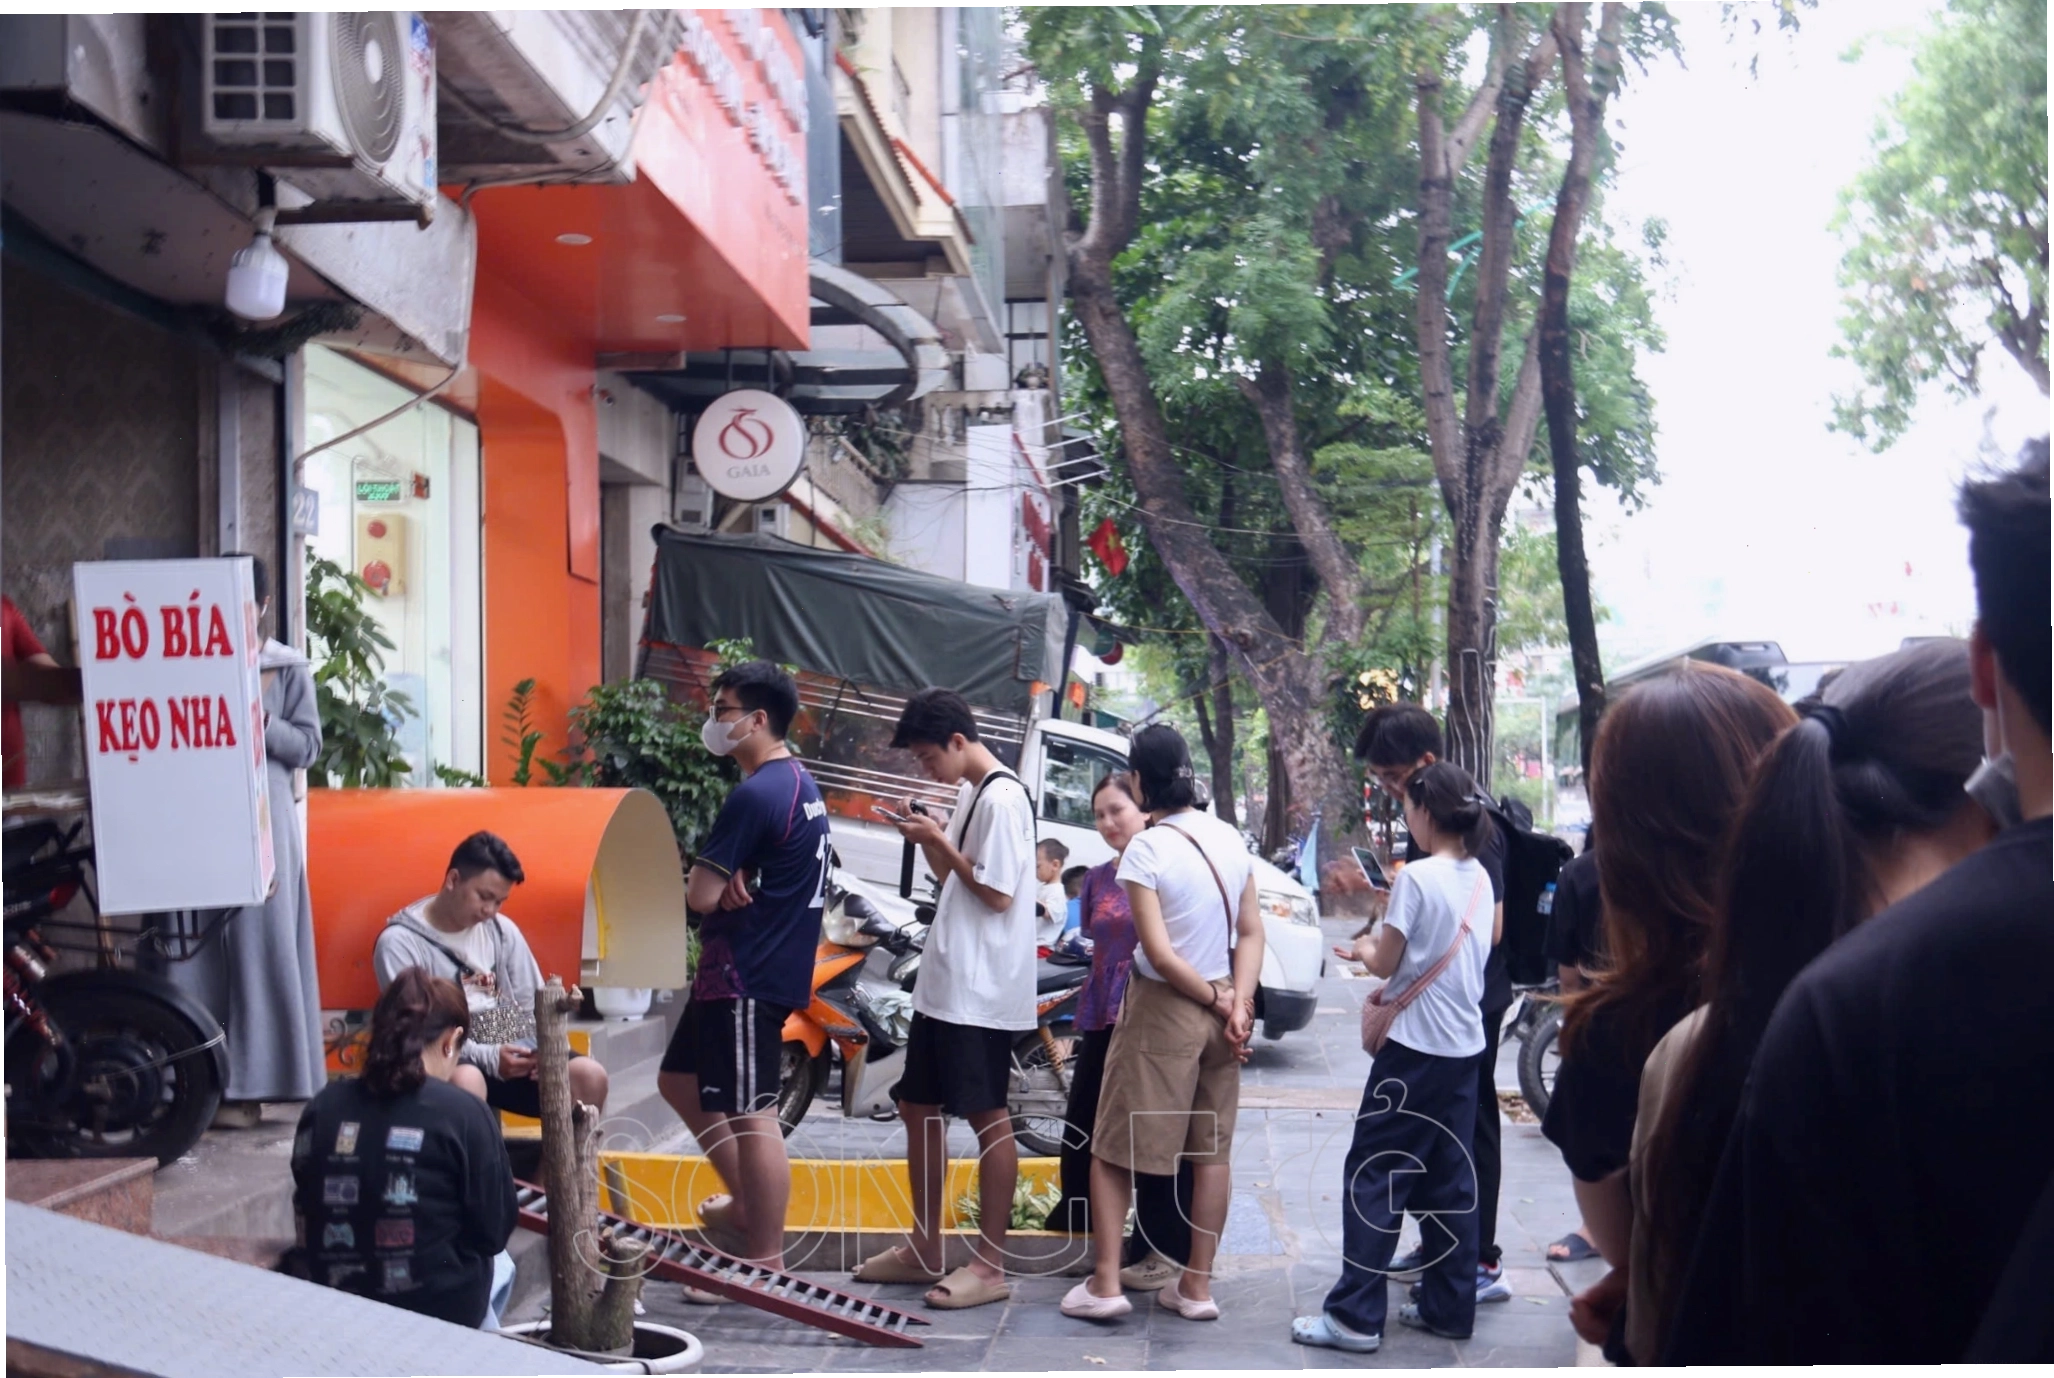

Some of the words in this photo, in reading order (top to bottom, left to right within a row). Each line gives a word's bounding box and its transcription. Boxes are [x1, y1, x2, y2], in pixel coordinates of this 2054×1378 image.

[727, 464, 771, 478] GAIA
[292, 492, 315, 529] 22
[92, 591, 149, 660] BÒ
[160, 589, 234, 657] BÍA
[96, 697, 162, 763] KẸO
[168, 693, 237, 749] NHA
